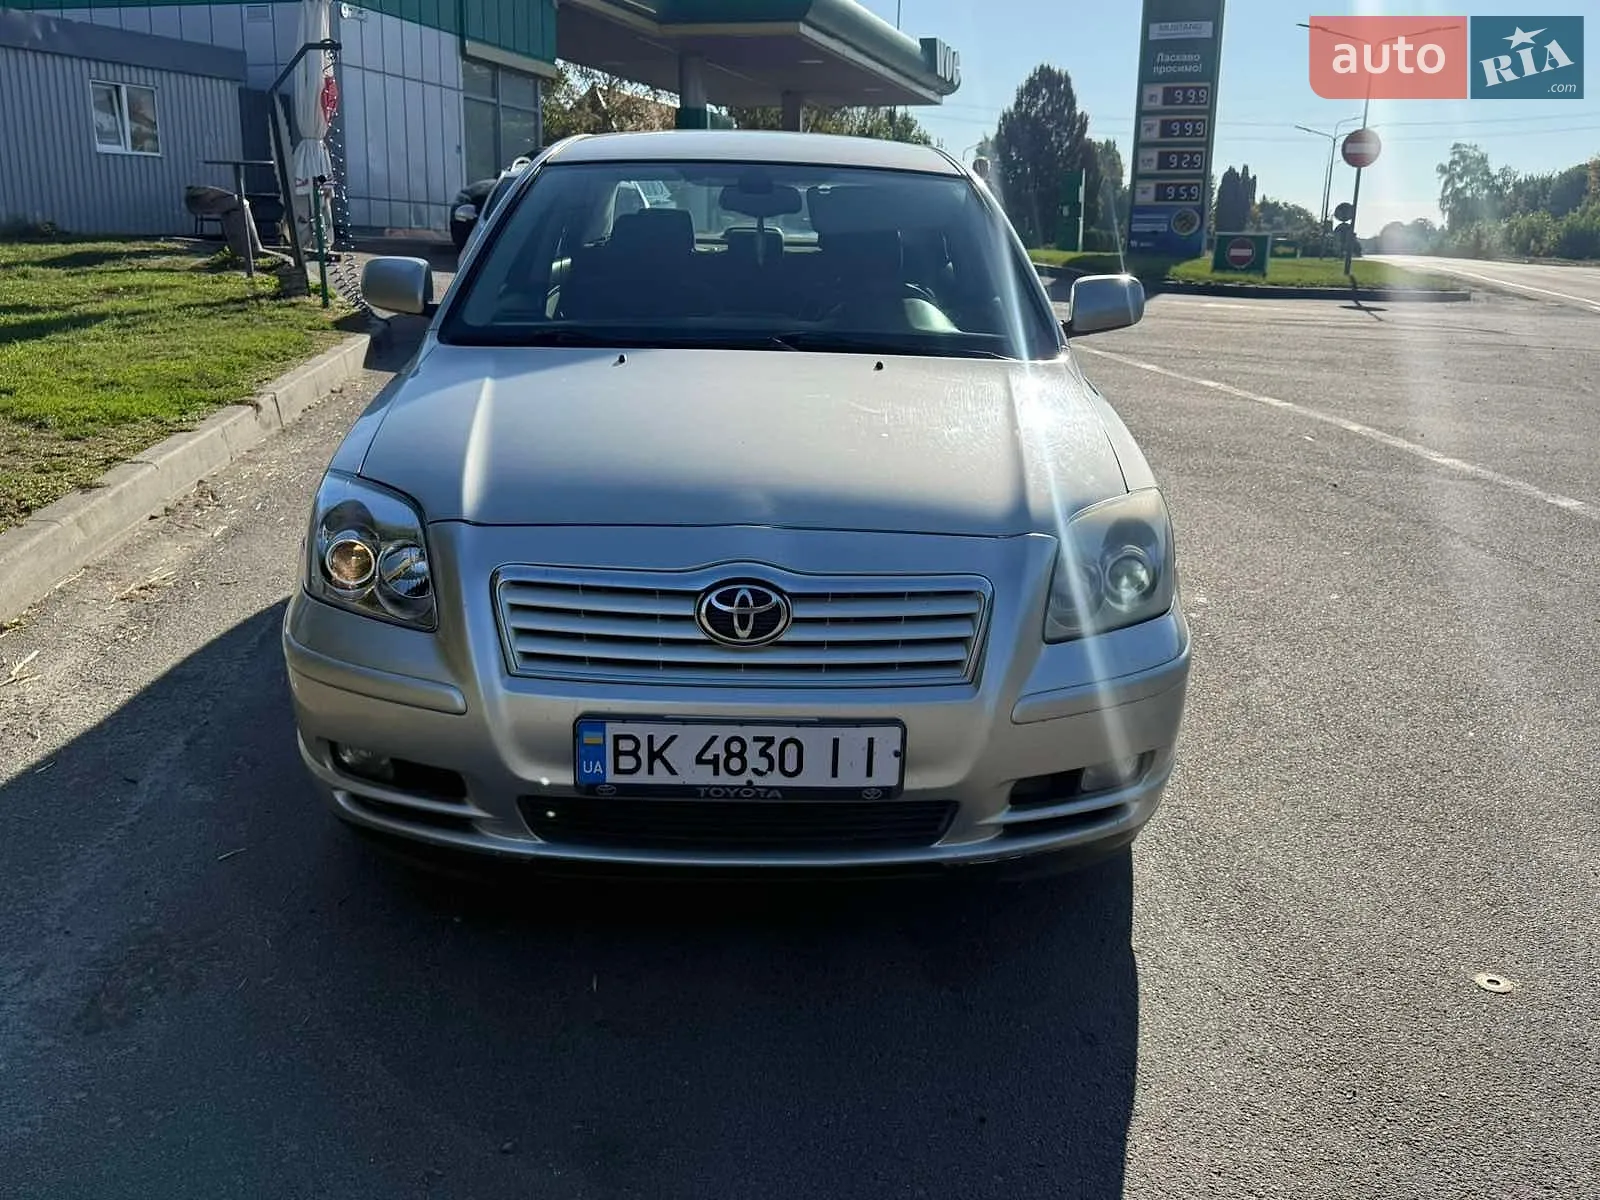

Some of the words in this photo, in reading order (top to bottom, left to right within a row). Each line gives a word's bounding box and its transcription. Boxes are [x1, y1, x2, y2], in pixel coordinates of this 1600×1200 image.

[1157, 52, 1200, 63] Ласкаво
[1153, 64, 1202, 75] просимо!
[612, 734, 679, 776] BK
[695, 735, 804, 778] 4830
[583, 760, 603, 775] UA
[696, 786, 783, 800] TOYOTA
